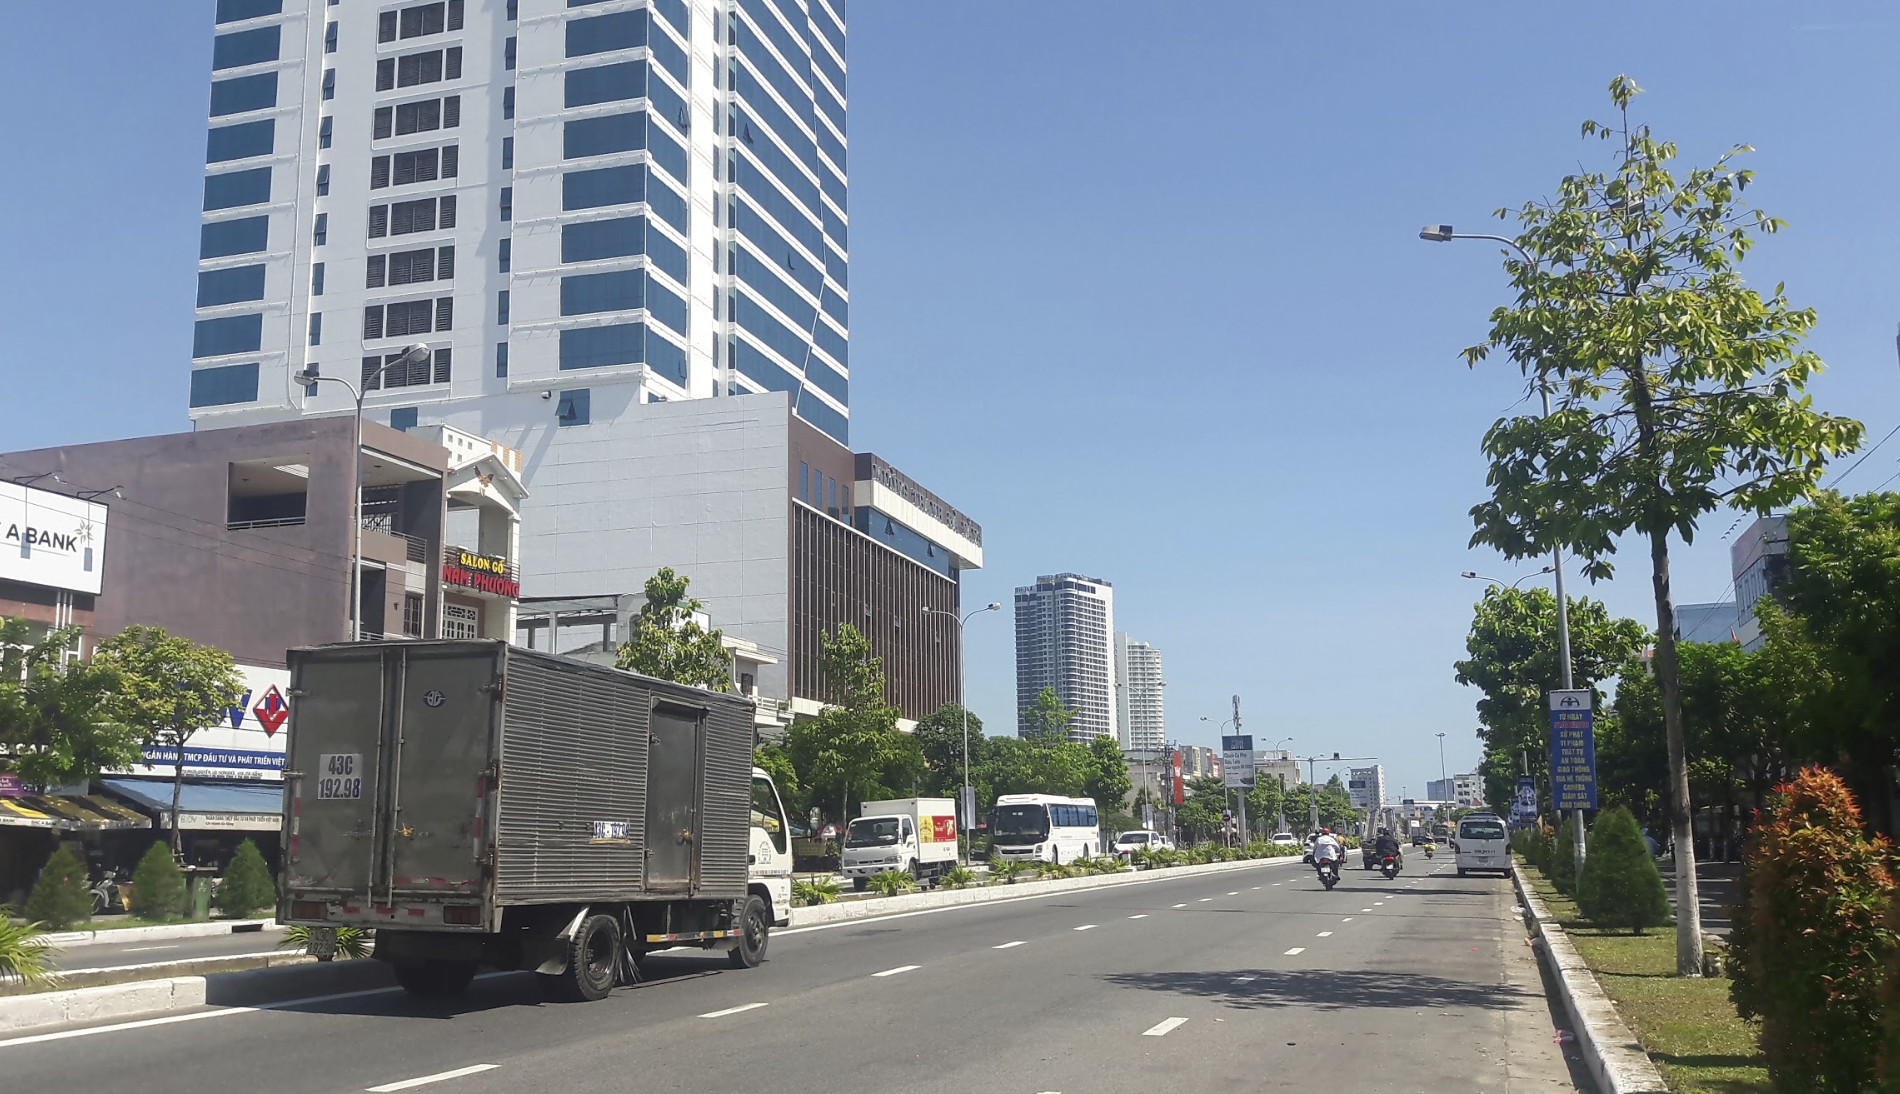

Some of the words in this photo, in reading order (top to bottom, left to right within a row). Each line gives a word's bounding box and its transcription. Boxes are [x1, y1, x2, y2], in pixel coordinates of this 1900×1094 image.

[6, 524, 20, 541] A
[26, 527, 77, 552] BANK
[460, 553, 490, 570] SALON
[443, 565, 470, 586] NAM
[163, 751, 178, 760] HÀN
[184, 753, 202, 762] TMCP
[203, 752, 218, 762] ĐẦU
[218, 754, 228, 762] TƯ
[228, 755, 236, 763] VÀ
[238, 756, 253, 764] PHÁT
[272, 757, 285, 767] VIỆT
[328, 756, 353, 775] 43C
[320, 778, 360, 798] 192.98
